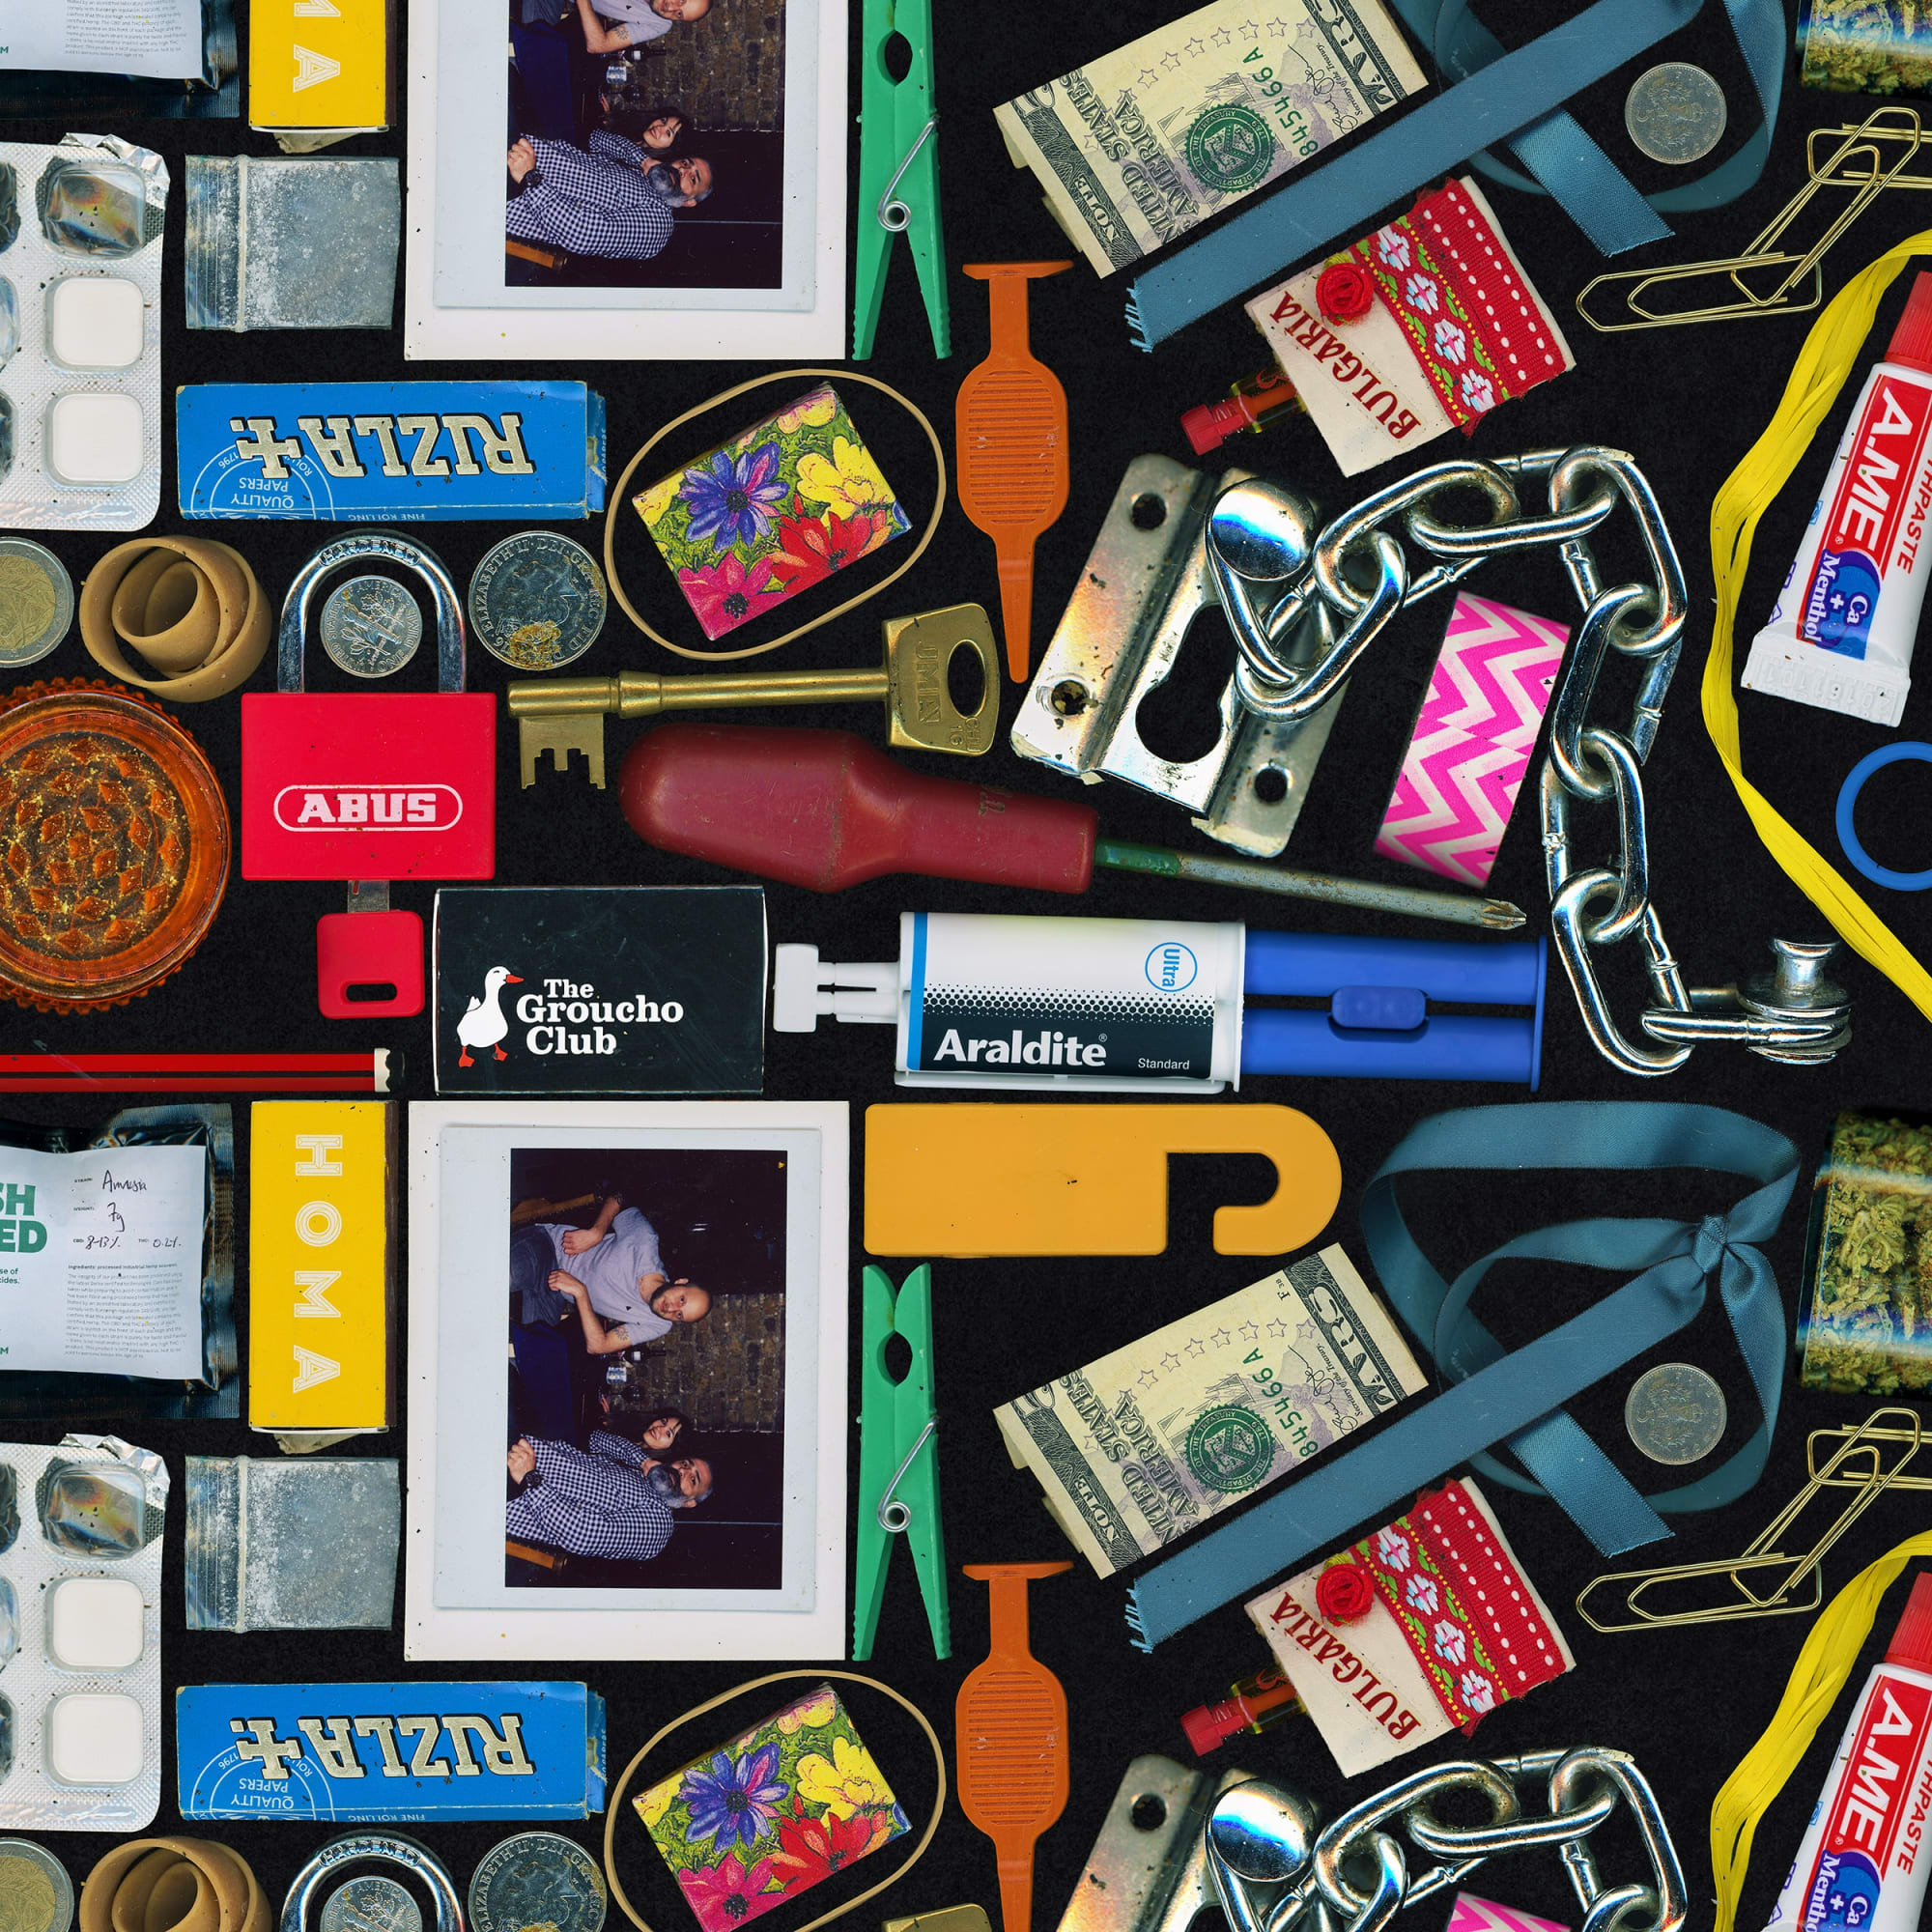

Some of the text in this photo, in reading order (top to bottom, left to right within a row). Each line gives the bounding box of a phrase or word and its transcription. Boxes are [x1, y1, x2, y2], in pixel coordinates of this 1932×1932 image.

[1242, 47, 1319, 156] 845466 A
[1116, 97, 1200, 220] AMERICA
[1075, 178, 1120, 242] NOTE
[218, 452, 239, 469] 1796
[1837, 384, 1913, 561] A.ME
[240, 477, 288, 492] PAPERS
[230, 494, 294, 509] QUALITY
[1897, 458, 1932, 574] HPASTE
[1804, 553, 1841, 643] Menthol
[1845, 594, 1868, 624] Ca
[298, 793, 436, 823] ABUS
[1162, 949, 1180, 986] Ultra
[544, 979, 594, 998] The
[516, 994, 684, 1023] Groucho
[526, 1026, 616, 1055] Club
[933, 1029, 1107, 1066] Araldite
[1138, 1058, 1190, 1070] Standard
[0, 1182, 36, 1215] H
[107, 1202, 125, 1232] 7g
[0, 1220, 47, 1253] ED
[293, 1134, 343, 1393] HOMA
[1242, 1349, 1319, 1457] 845466 A
[1116, 1397, 1200, 1520] AMERICA
[1075, 1478, 1120, 1542] NOTE
[218, 1752, 239, 1770] 1796
[1837, 1685, 1913, 1862] A.ME
[230, 1795, 294, 1809] QUALITY
[240, 1778, 288, 1793] PAPERS
[1897, 1758, 1932, 1875] HPASTE
[1845, 1895, 1868, 1924] Ca
